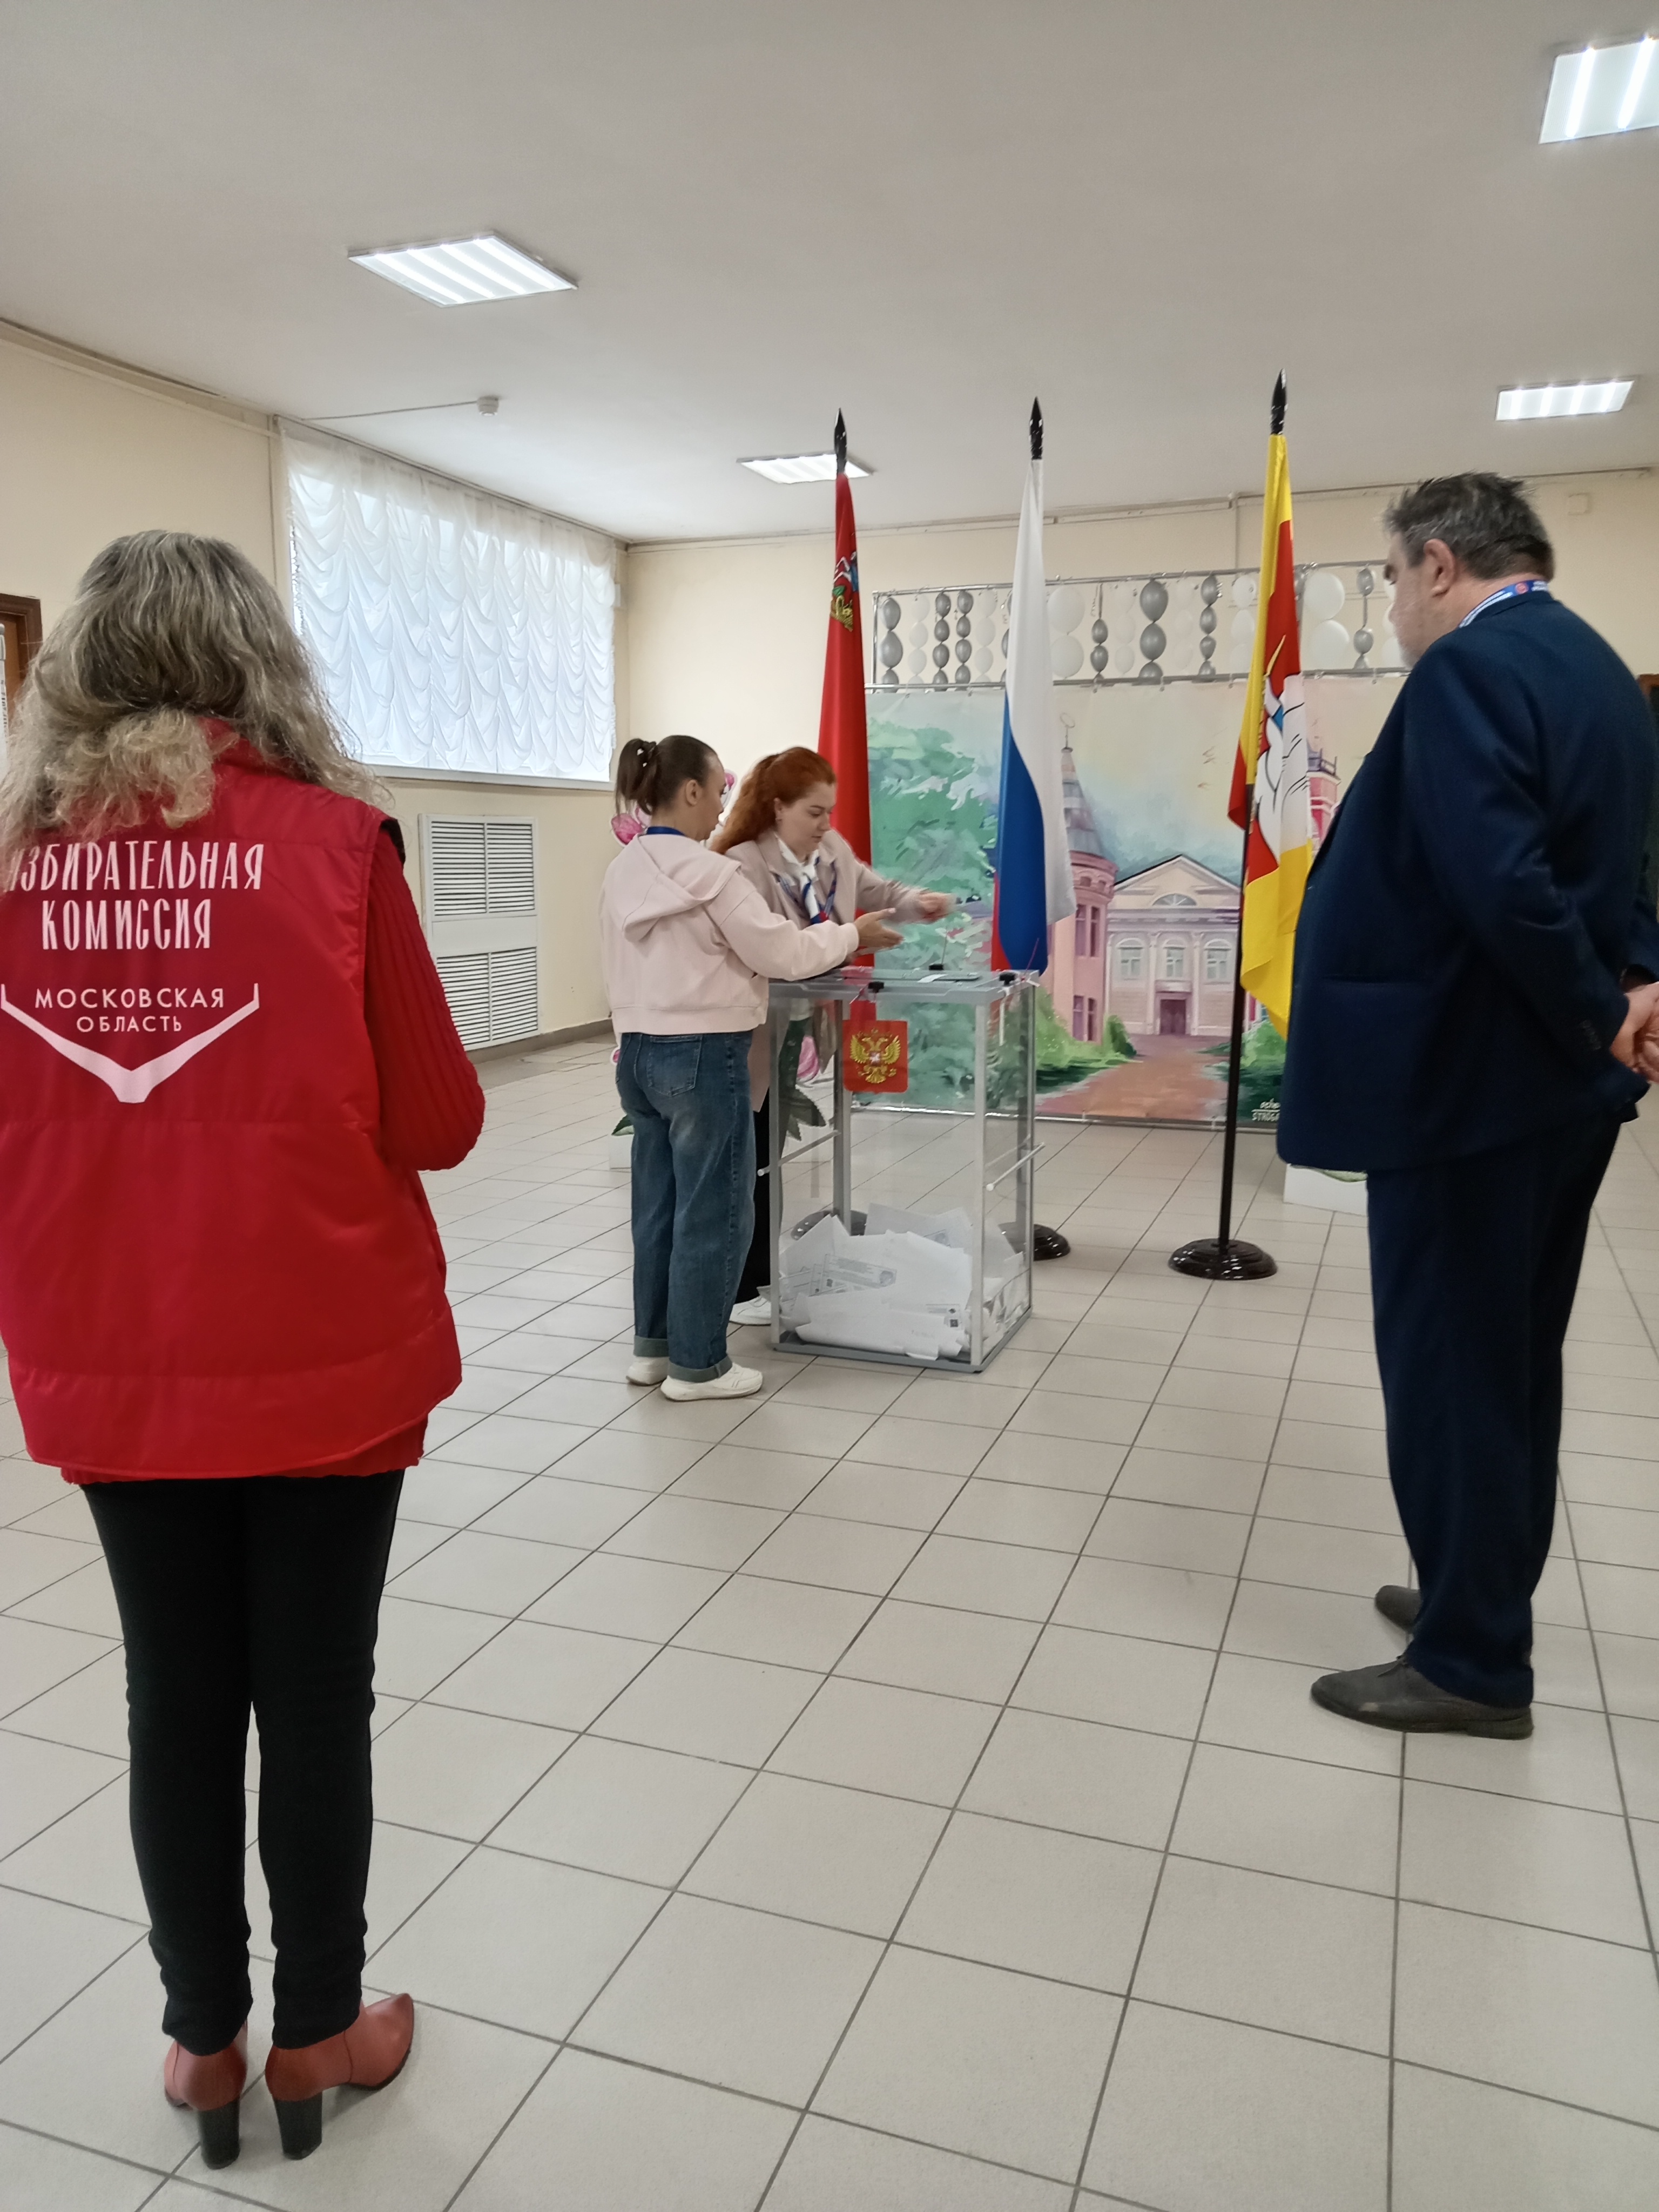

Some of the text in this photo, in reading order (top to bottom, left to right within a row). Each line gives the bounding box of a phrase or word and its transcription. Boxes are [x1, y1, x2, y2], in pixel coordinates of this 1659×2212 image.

[42, 898, 211, 950] КОМИССИЯ
[35, 988, 224, 1008] МОСКОВСКАЯ
[77, 1016, 182, 1033] ОБЛАСТЬ
